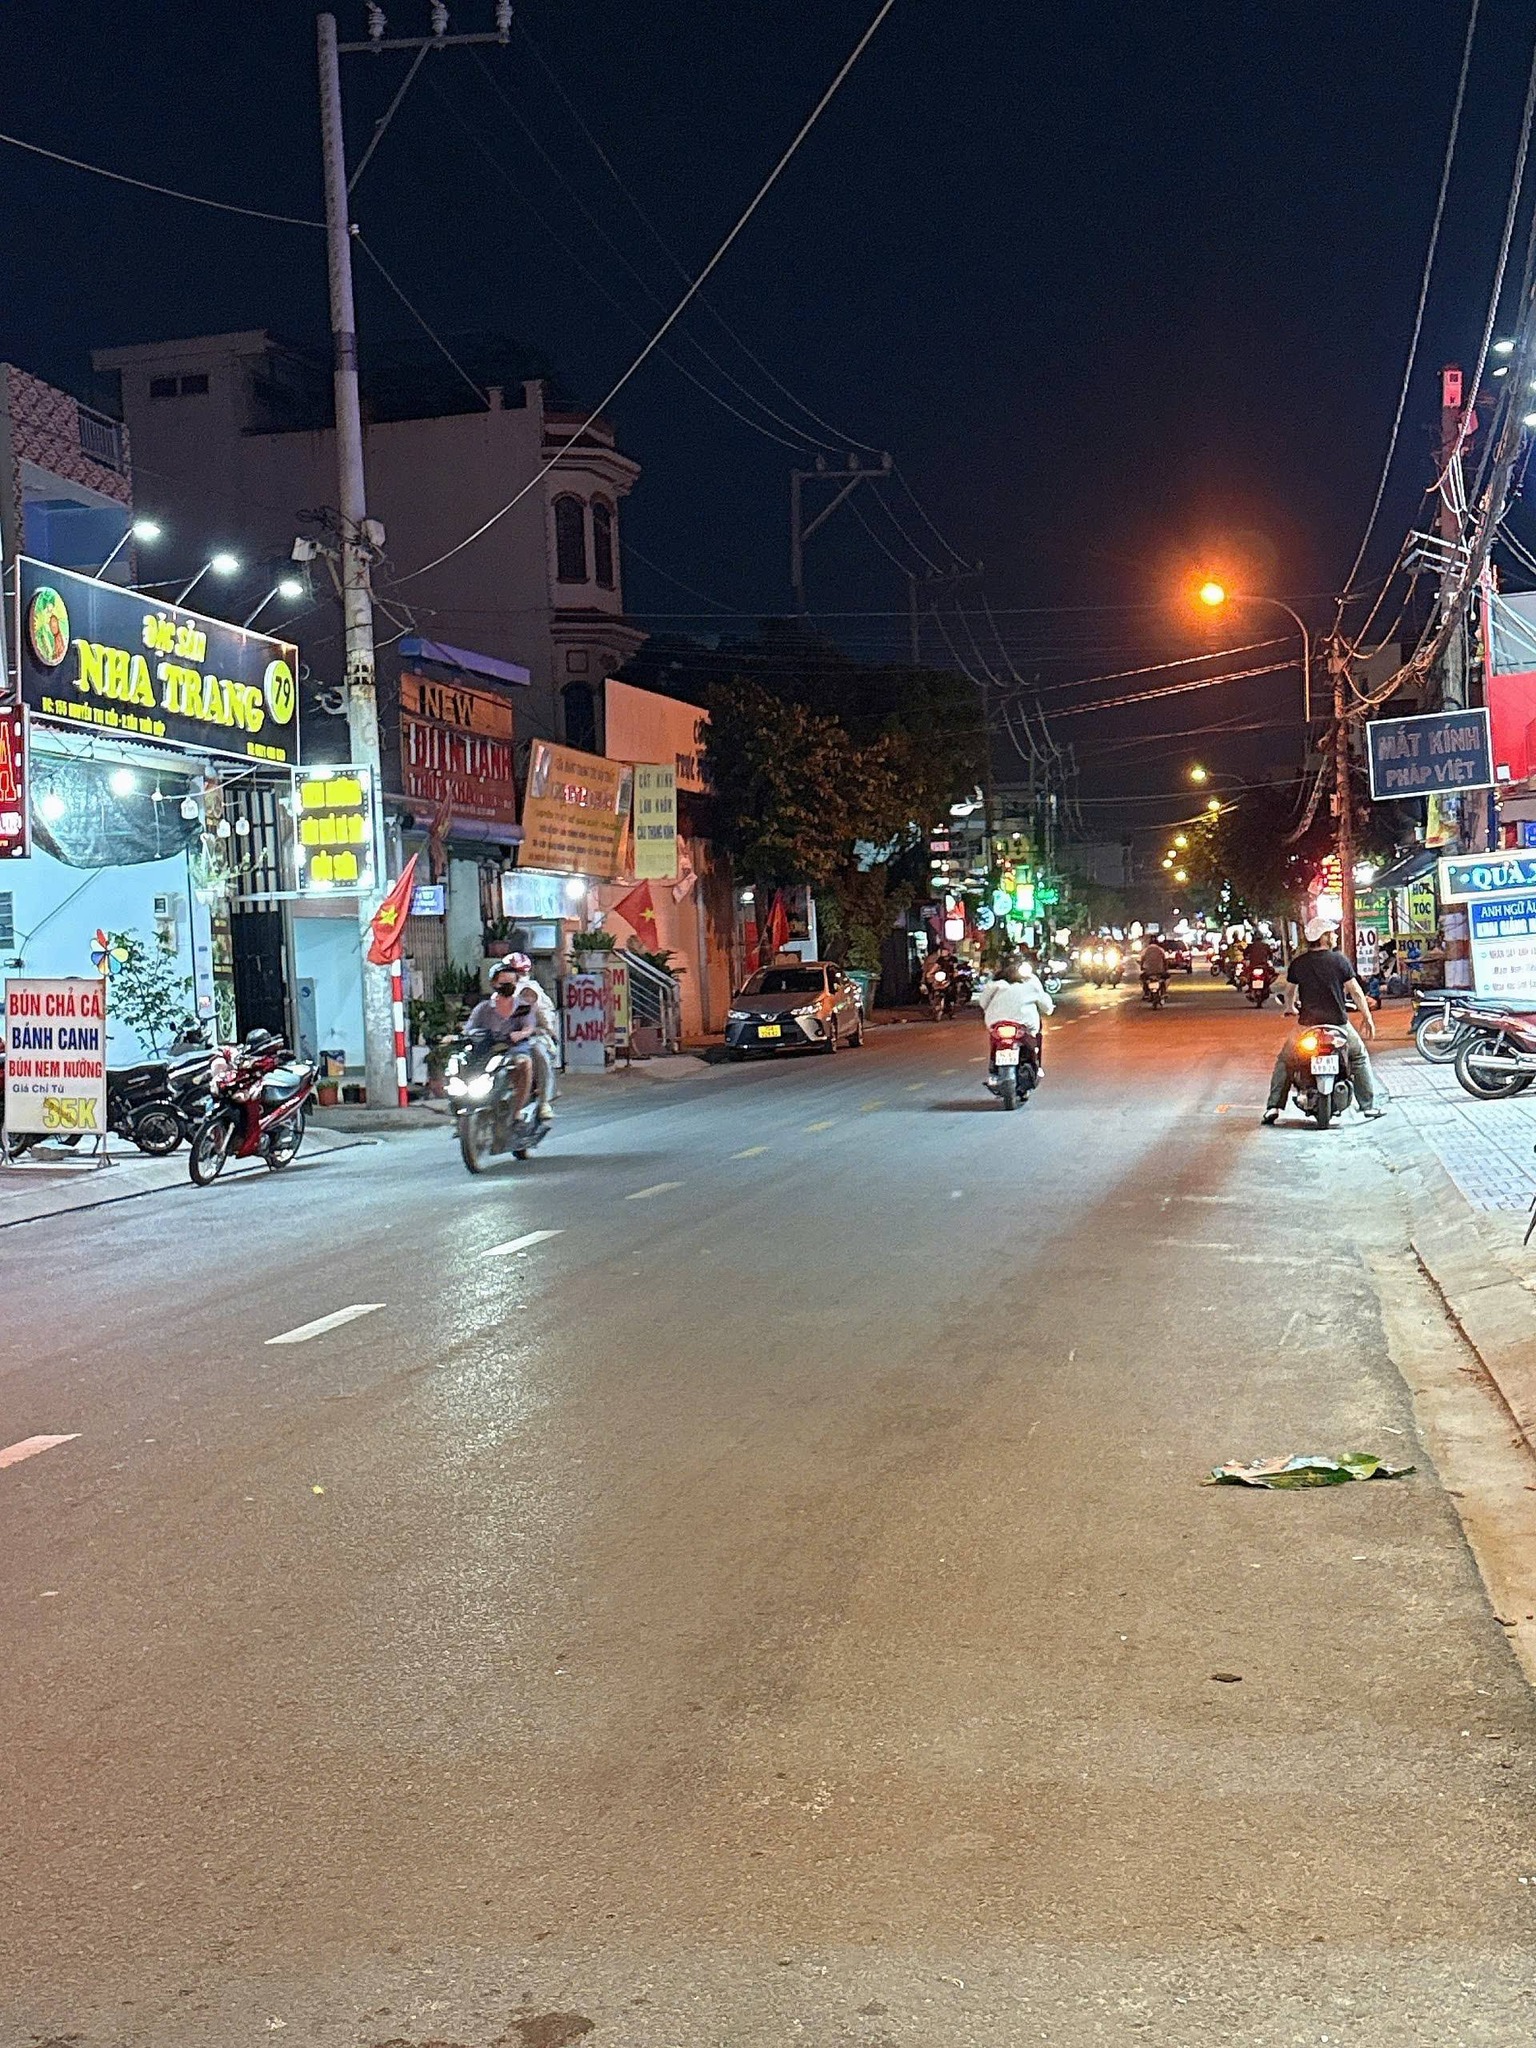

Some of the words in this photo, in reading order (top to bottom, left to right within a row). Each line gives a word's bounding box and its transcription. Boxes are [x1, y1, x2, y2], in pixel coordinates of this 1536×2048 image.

[72, 638, 156, 708] NHA
[157, 661, 265, 734] TRANG
[275, 675, 292, 710] 79
[9, 989, 41, 1017] BÚN
[45, 987, 76, 1017] CHẢ
[12, 1021, 53, 1050] BÁNH
[58, 1026, 99, 1051] CANH
[9, 1056, 32, 1077] BÚN
[35, 1060, 60, 1078] NEM
